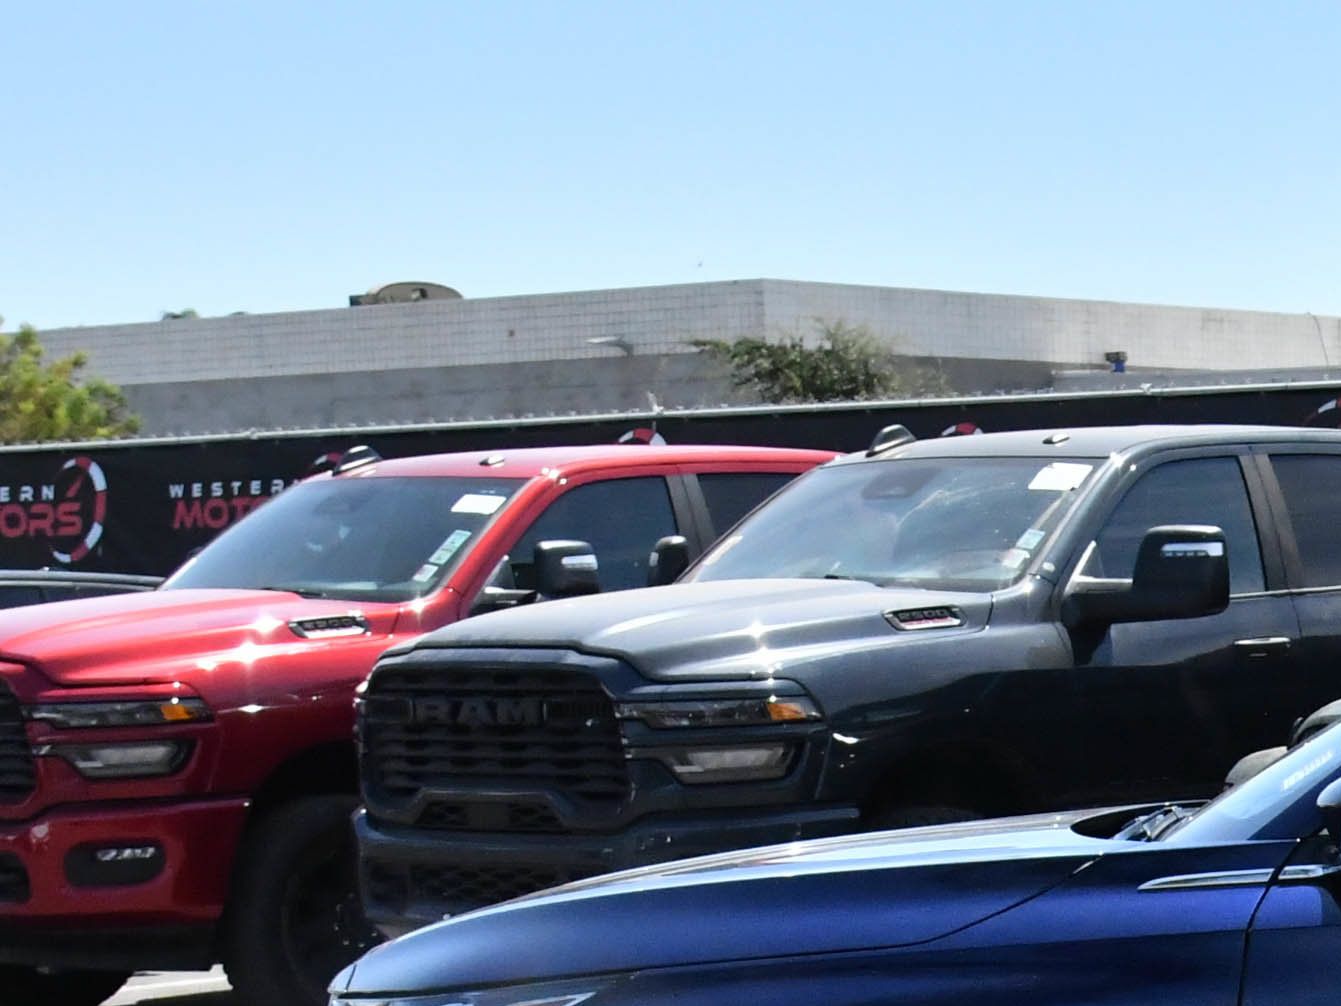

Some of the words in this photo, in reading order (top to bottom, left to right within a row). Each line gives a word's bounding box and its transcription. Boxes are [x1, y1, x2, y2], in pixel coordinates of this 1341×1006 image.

[0, 484, 54, 502] ERN
[0, 502, 83, 538] ORS
[173, 496, 269, 529] MOT
